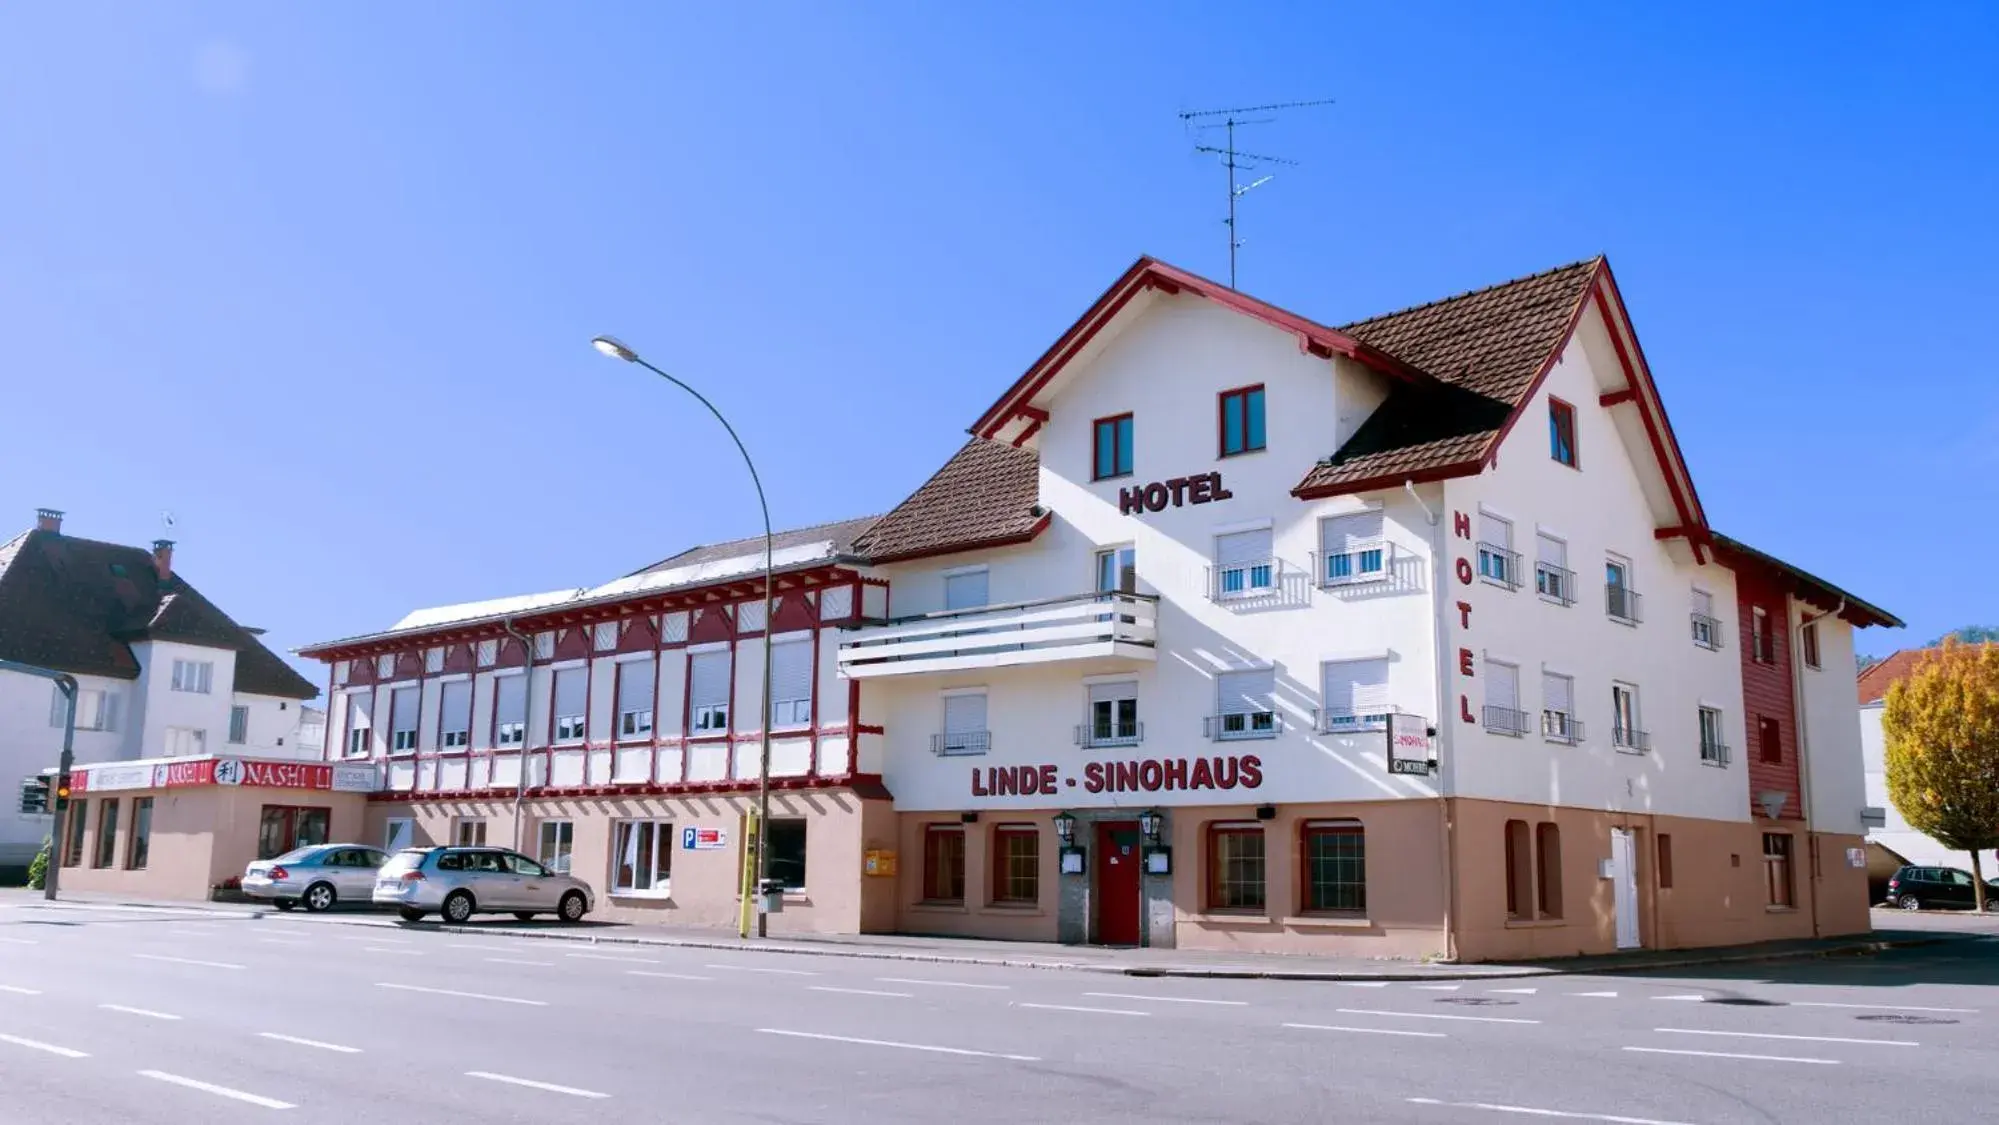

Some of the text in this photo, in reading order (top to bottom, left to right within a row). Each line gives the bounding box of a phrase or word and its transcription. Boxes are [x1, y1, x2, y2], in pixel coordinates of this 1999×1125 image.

[1119, 471, 1233, 516] HOTEL
[1454, 510, 1475, 724] HOTEL
[246, 763, 305, 787] NASHI
[315, 767, 331, 788] LI
[972, 765, 1058, 796] LINDE
[1083, 755, 1263, 793] SINOHAUS
[685, 830, 693, 847] P
